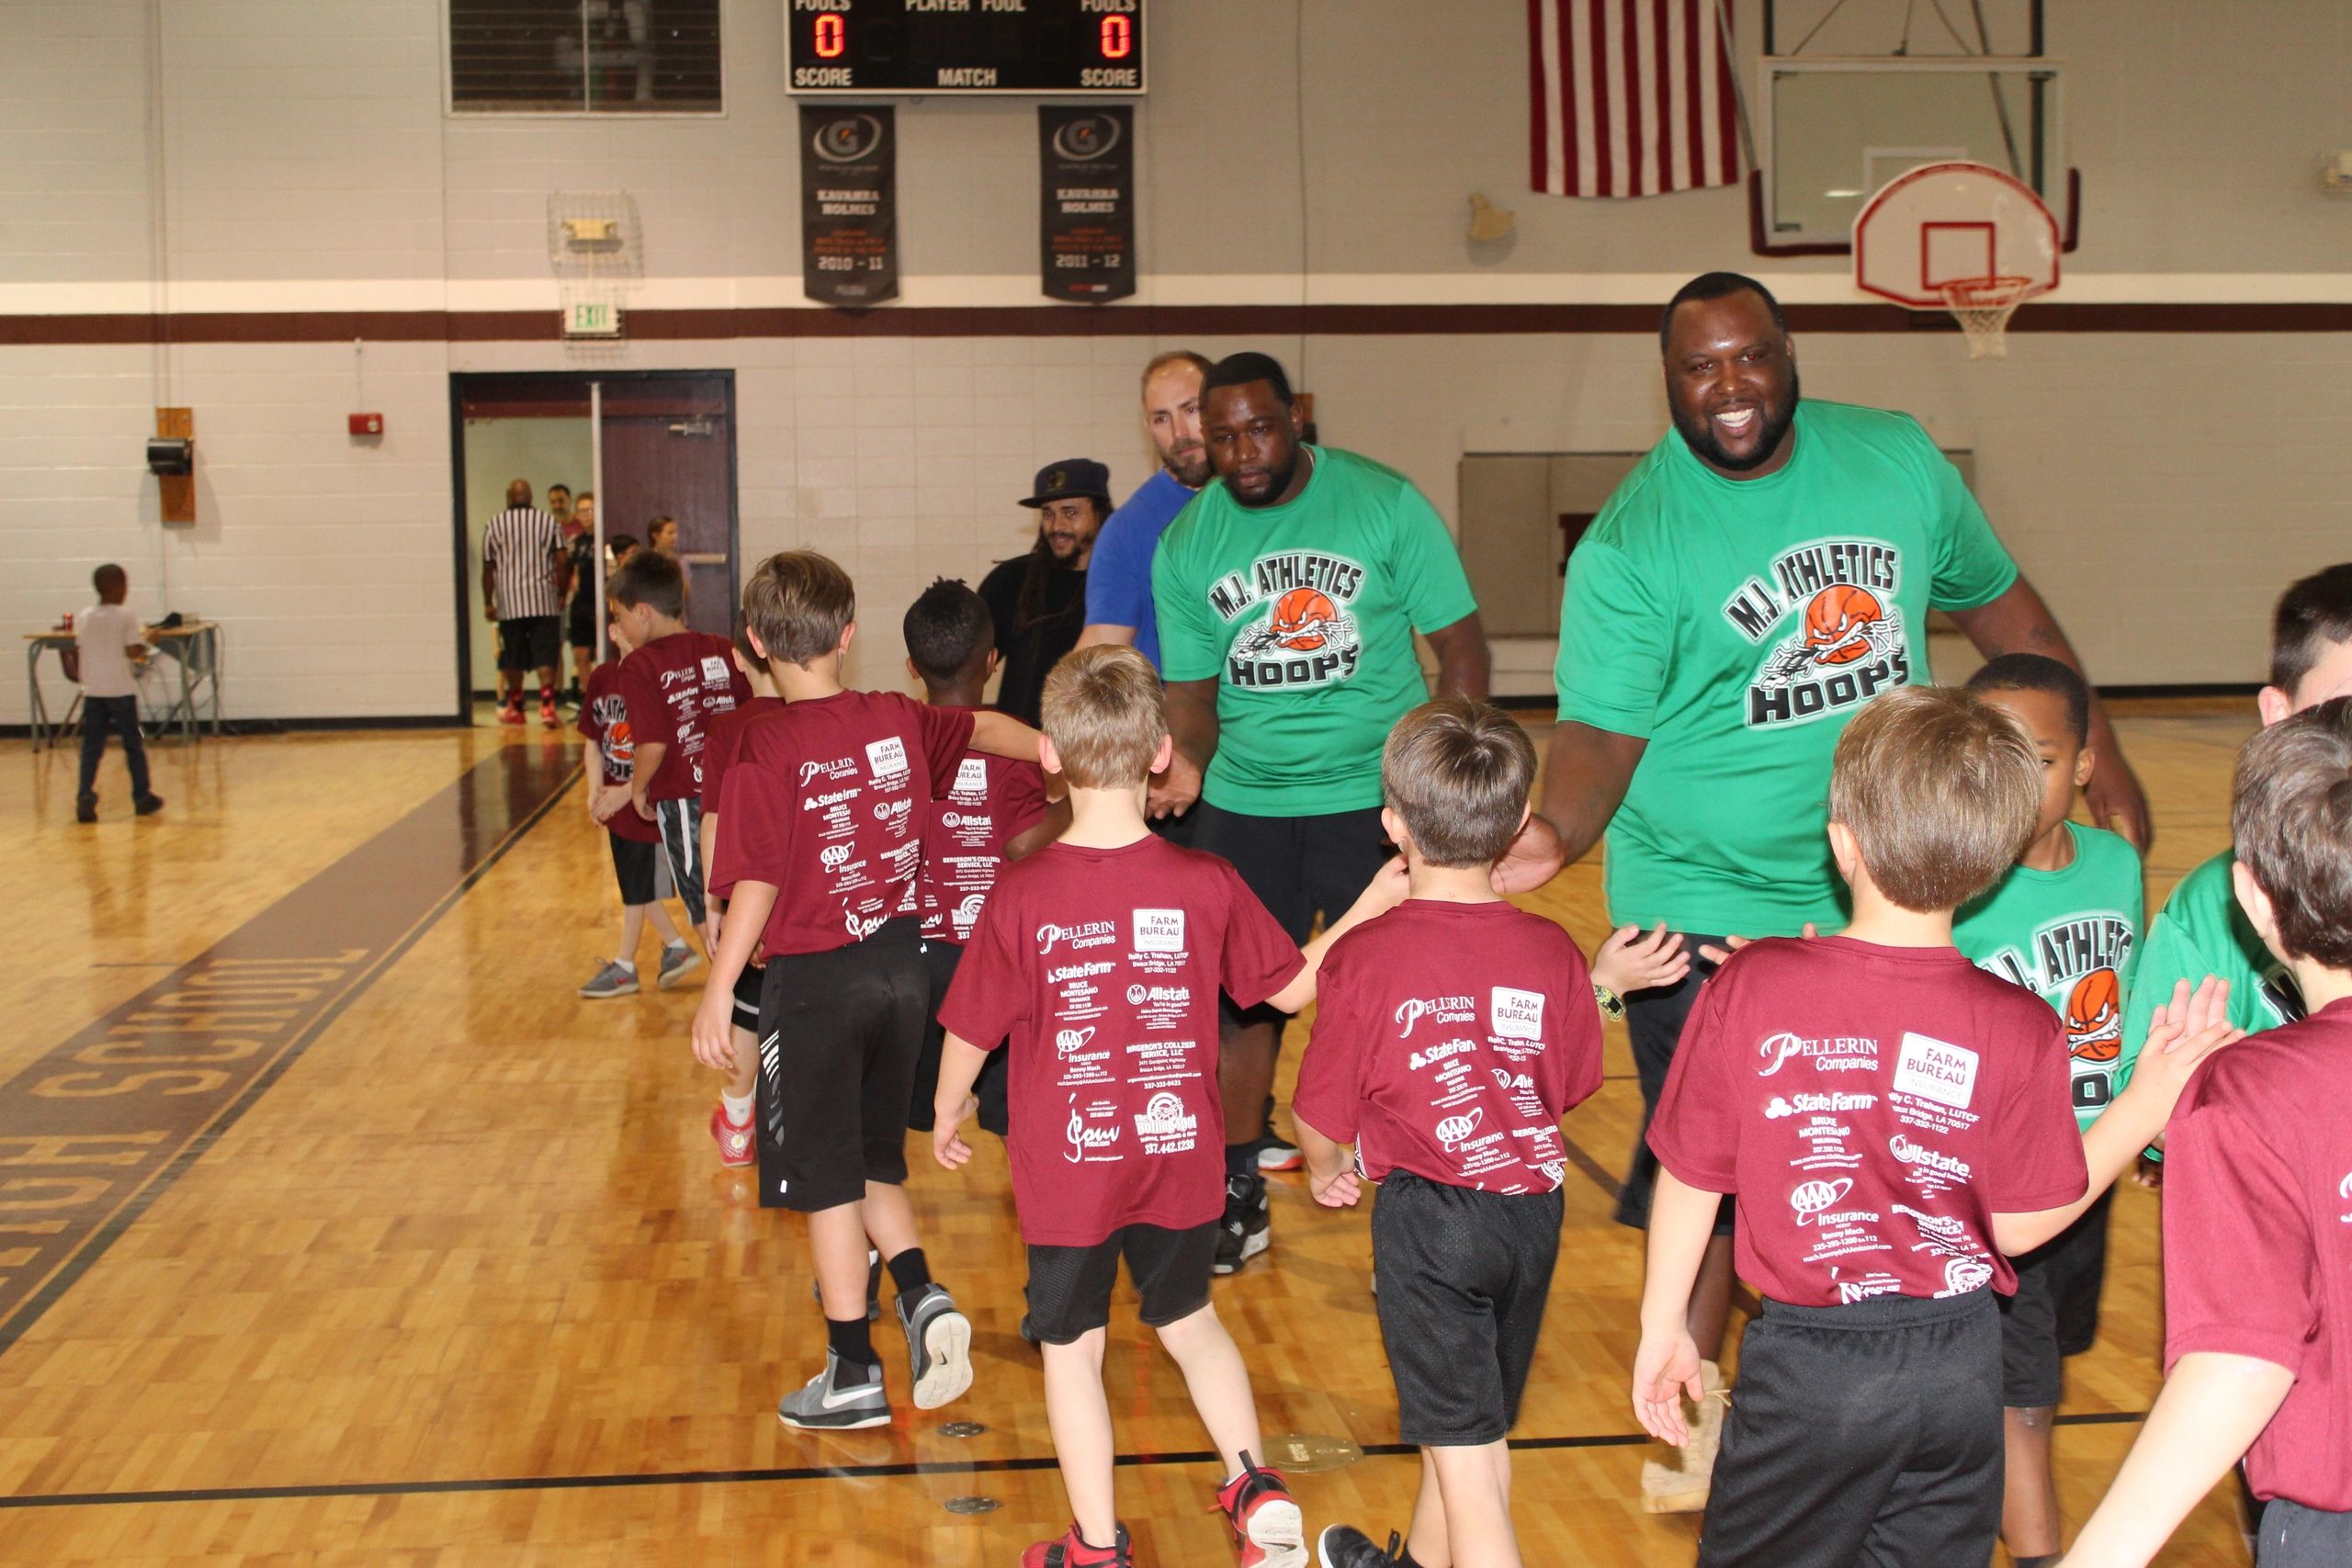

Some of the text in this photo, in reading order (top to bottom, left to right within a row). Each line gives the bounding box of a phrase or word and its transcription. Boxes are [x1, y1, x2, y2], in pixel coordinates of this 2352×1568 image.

[816, 15, 844, 57] 0
[1102, 16, 1130, 58] 0
[795, 67, 853, 86] SCORE
[938, 68, 997, 86] MATCH
[1080, 68, 1136, 86] SCORE
[822, 203, 876, 215] HOLMES
[1061, 202, 1114, 212] HOLMES
[818, 257, 853, 270] 2010
[1056, 254, 1088, 267] 2011
[575, 304, 607, 328] EXIT
[1210, 556, 1363, 619] M.J. ATHLETICS
[1727, 544, 1895, 638] M.J. ATHLETICS
[1228, 644, 1359, 686] HOOPS
[1750, 645, 1908, 725] HOOPS
[880, 742, 900, 752] FARM
[874, 750, 903, 763] BUREAU
[840, 860, 866, 874] Insurance
[1151, 916, 1179, 925] FARM
[1037, 921, 1114, 954] PELLERIN
[1140, 927, 1179, 936] BUREAU
[1072, 934, 1116, 950] Companies
[1060, 987, 1098, 998] MONTESANO
[1069, 981, 1088, 989] BRUCE
[1511, 997, 1538, 1011] FARM
[29, 949, 369, 1098] SCHOOL
[1498, 1008, 1538, 1022] BUREAU
[1069, 1052, 1110, 1063] Insurance
[1758, 1032, 1878, 1077] PELLERIN
[1926, 1047, 1966, 1071] FARM
[1070, 1066, 1086, 1074] Benny
[1816, 1056, 1878, 1073] Companies
[1906, 1058, 1966, 1085] BUREAU
[1904, 1095, 1913, 1105] C.
[1915, 1098, 1947, 1115] Trahan,
[1949, 1108, 1980, 1122] LUTCF
[1900, 1115, 1949, 1134] 337-332-1122
[1909, 1108, 1934, 1122] Bridge,
[1936, 1115, 1946, 1123] LA
[1947, 1119, 1970, 1131] 70517
[1929, 1168, 1945, 1179] good
[1796, 1182, 1833, 1211] AAA
[1818, 1212, 1879, 1226] Insurance
[1822, 1227, 1865, 1241] Benny Mach
